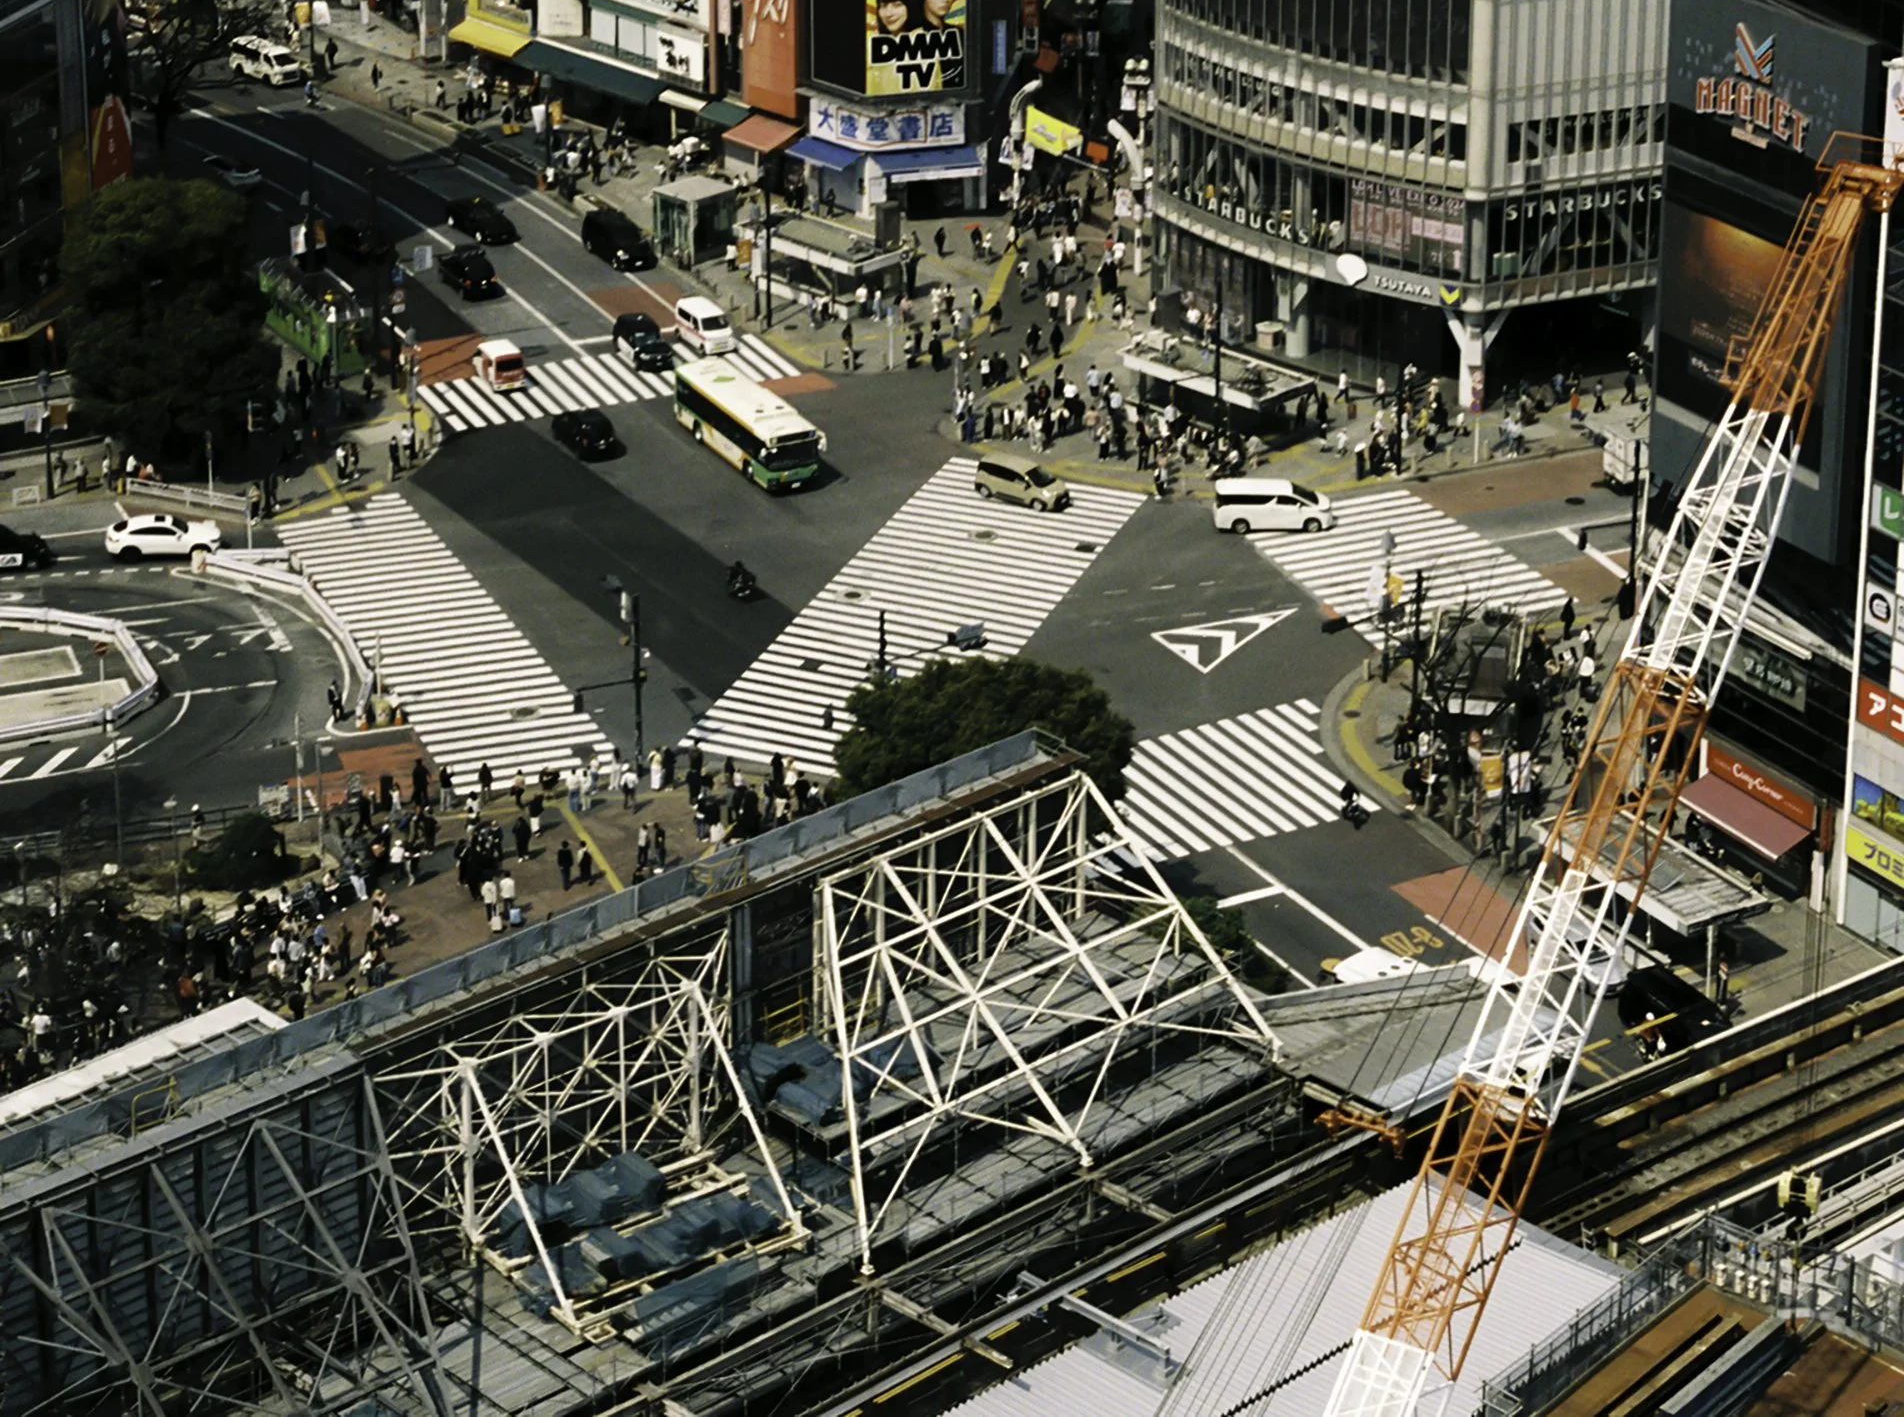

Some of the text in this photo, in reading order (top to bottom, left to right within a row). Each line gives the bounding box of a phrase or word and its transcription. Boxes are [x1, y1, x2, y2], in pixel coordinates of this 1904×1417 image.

[870, 29, 963, 64] DMM
[896, 62, 936, 90] TV
[818, 108, 953, 142] 大盛堂書店
[1695, 76, 1809, 153] MAGNET
[1185, 186, 1310, 245] STARBUCKS
[1505, 184, 1663, 221] STARBUCKS
[1374, 275, 1433, 298] TSUTAYA
